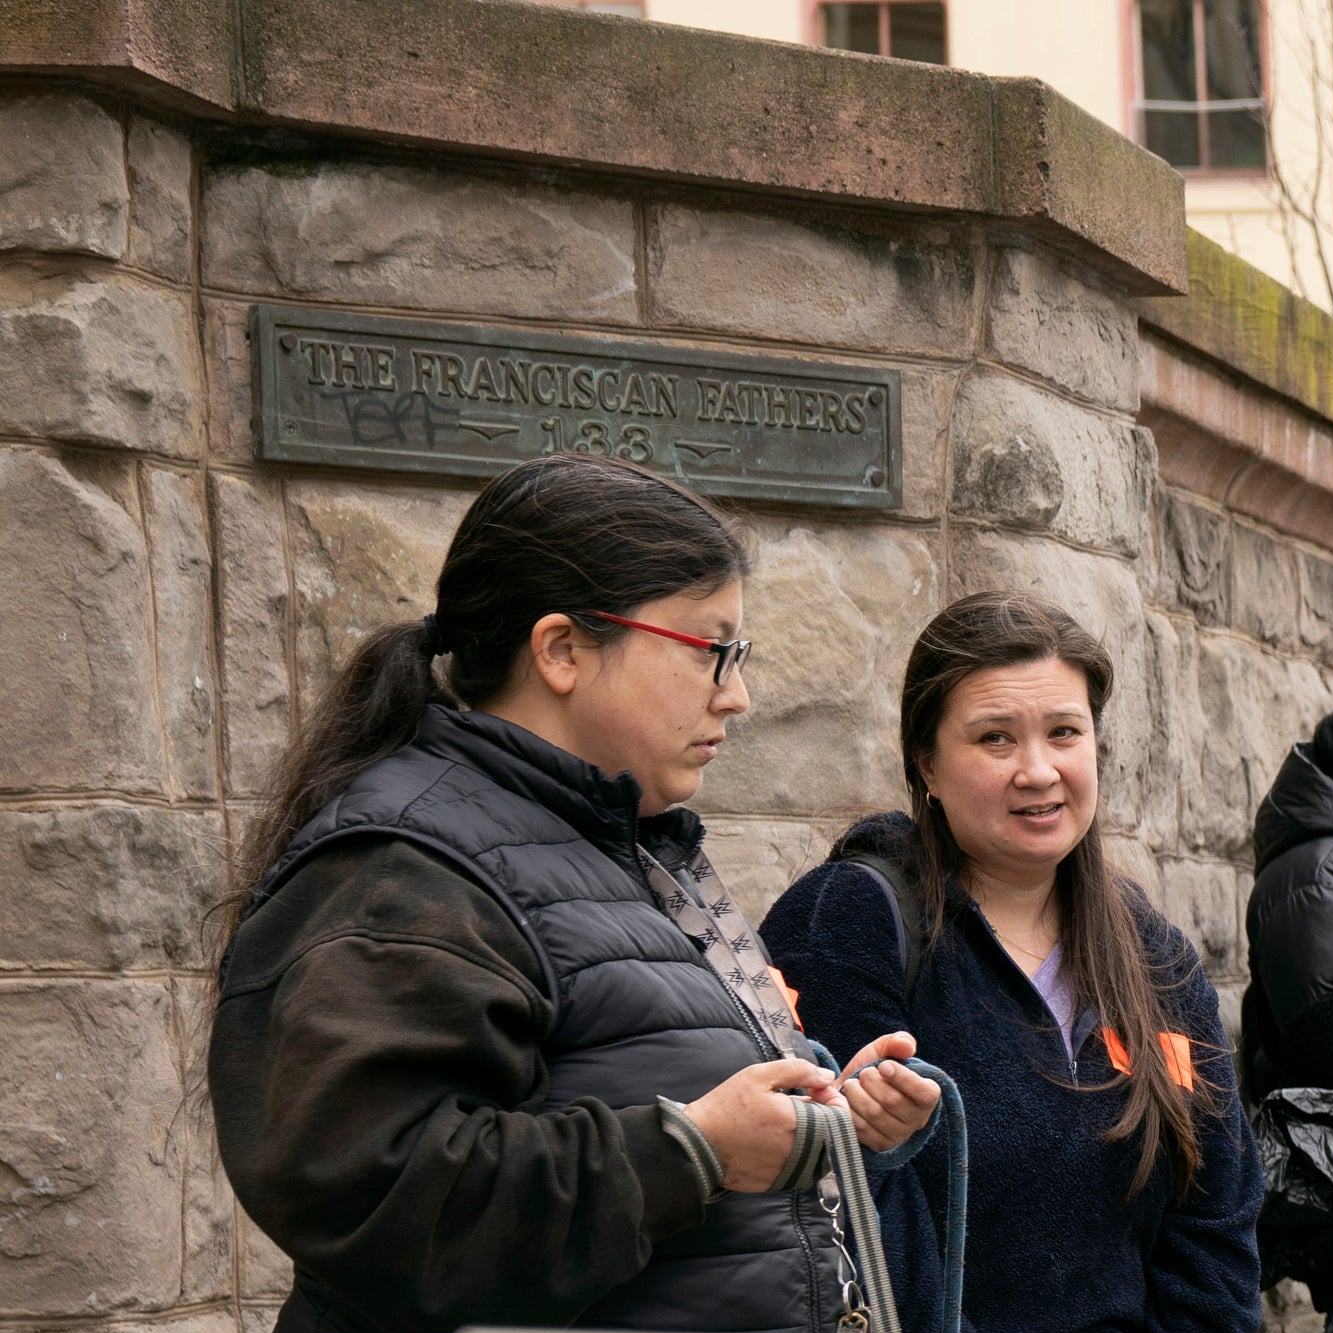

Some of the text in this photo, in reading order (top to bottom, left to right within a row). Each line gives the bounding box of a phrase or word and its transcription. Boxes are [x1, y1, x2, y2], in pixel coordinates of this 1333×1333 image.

[300, 339, 870, 436] THE FRANCISCAN FATHERS
